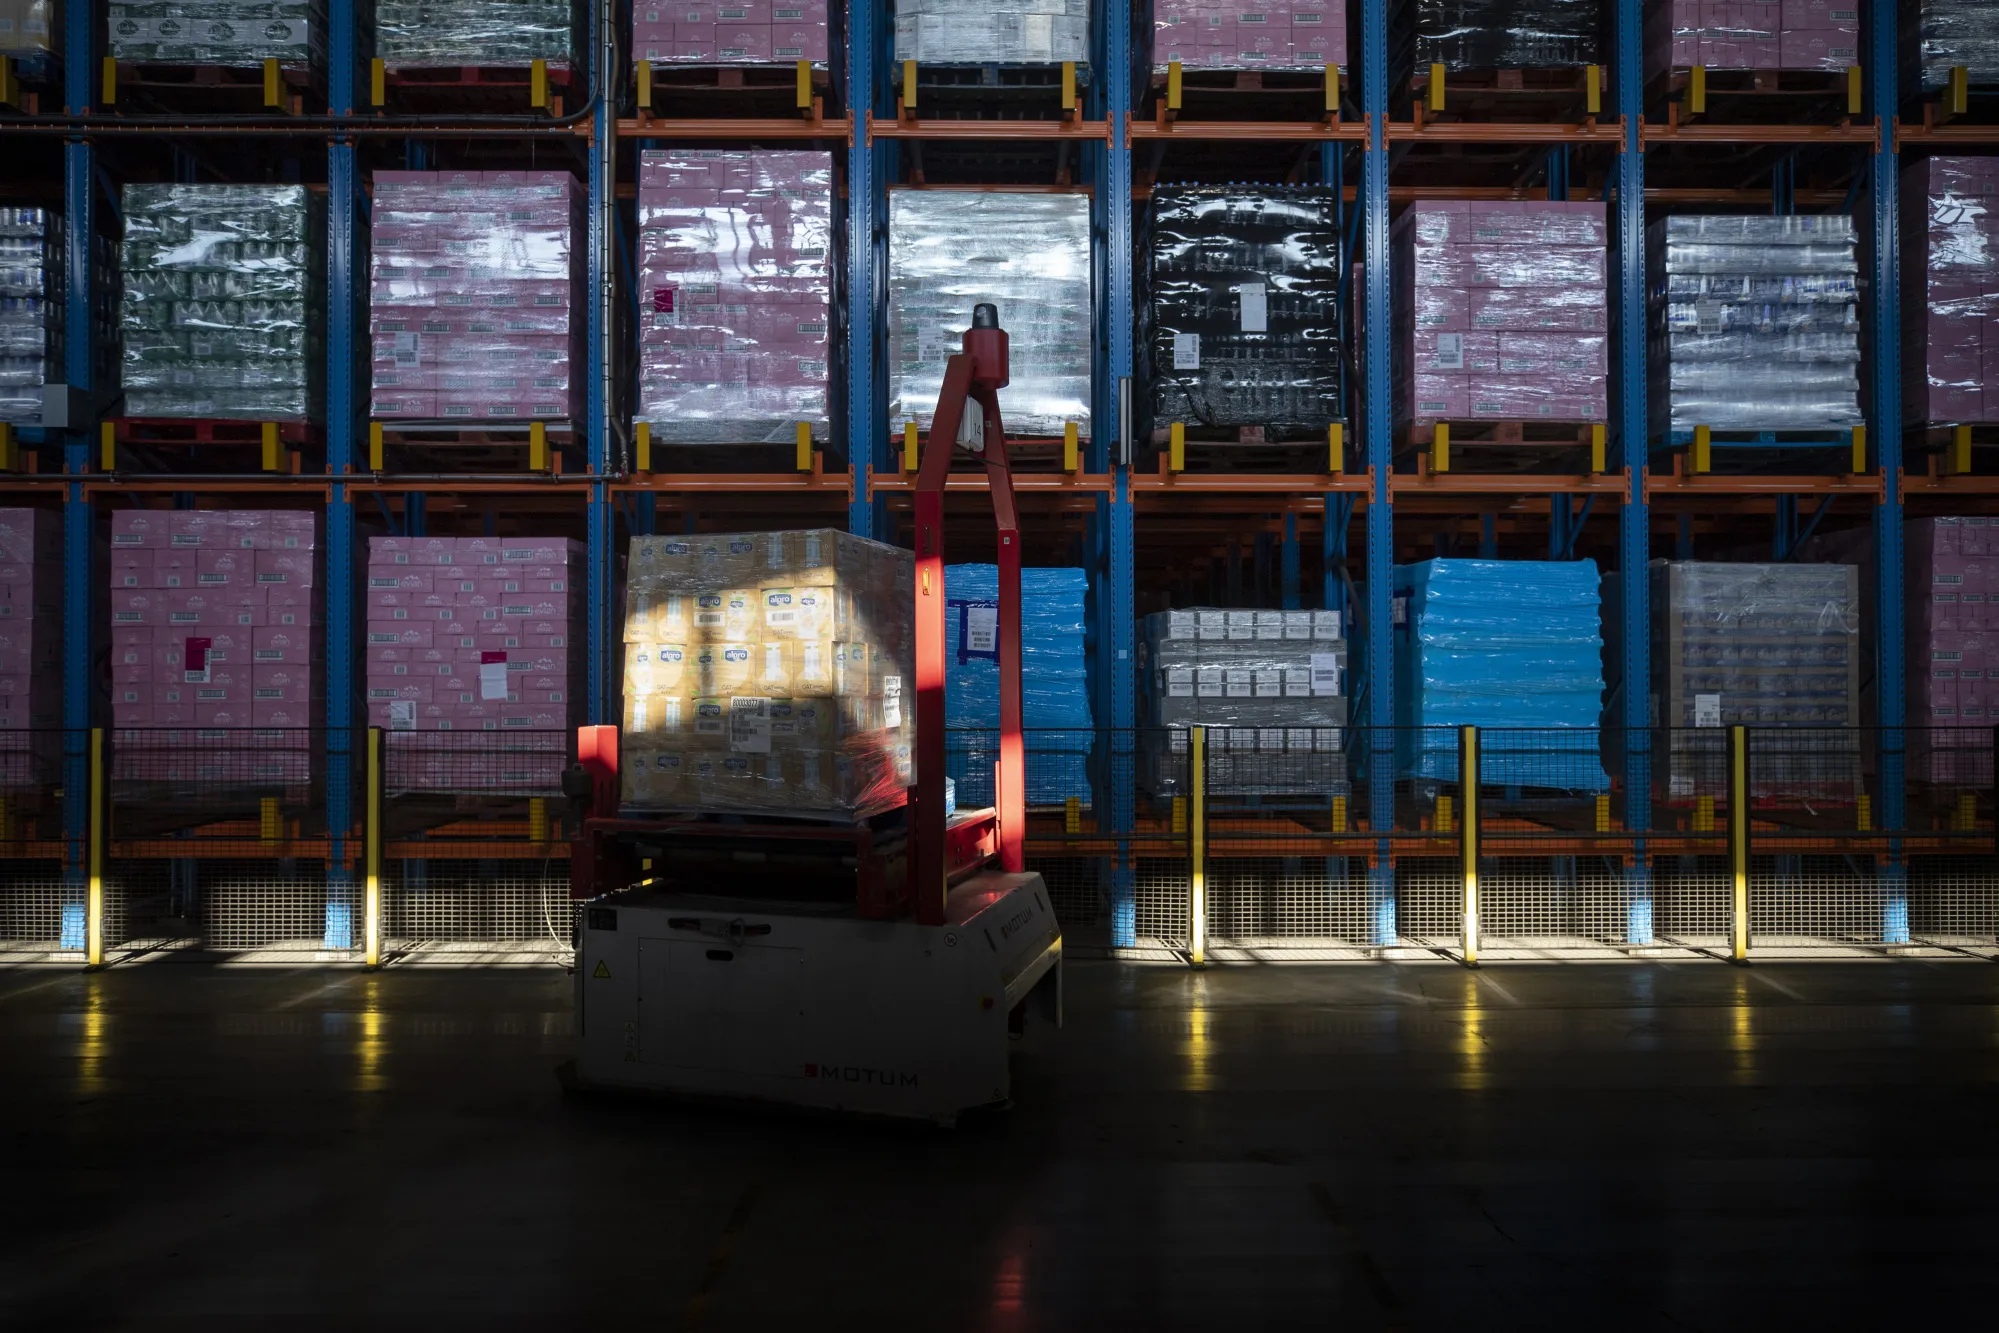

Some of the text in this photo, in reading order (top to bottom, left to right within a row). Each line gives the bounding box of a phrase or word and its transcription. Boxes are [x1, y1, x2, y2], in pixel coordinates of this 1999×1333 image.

[403, 403, 425, 412] evian
[974, 422, 983, 437] 14
[731, 542, 752, 553] alpro
[700, 596, 721, 607] alpro
[769, 595, 792, 606] alpro
[661, 651, 682, 662] alpro
[726, 651, 748, 661] alpro
[700, 704, 720, 715] alpro
[1005, 907, 1033, 935] MOTUM
[822, 1065, 918, 1088] MOTUM
